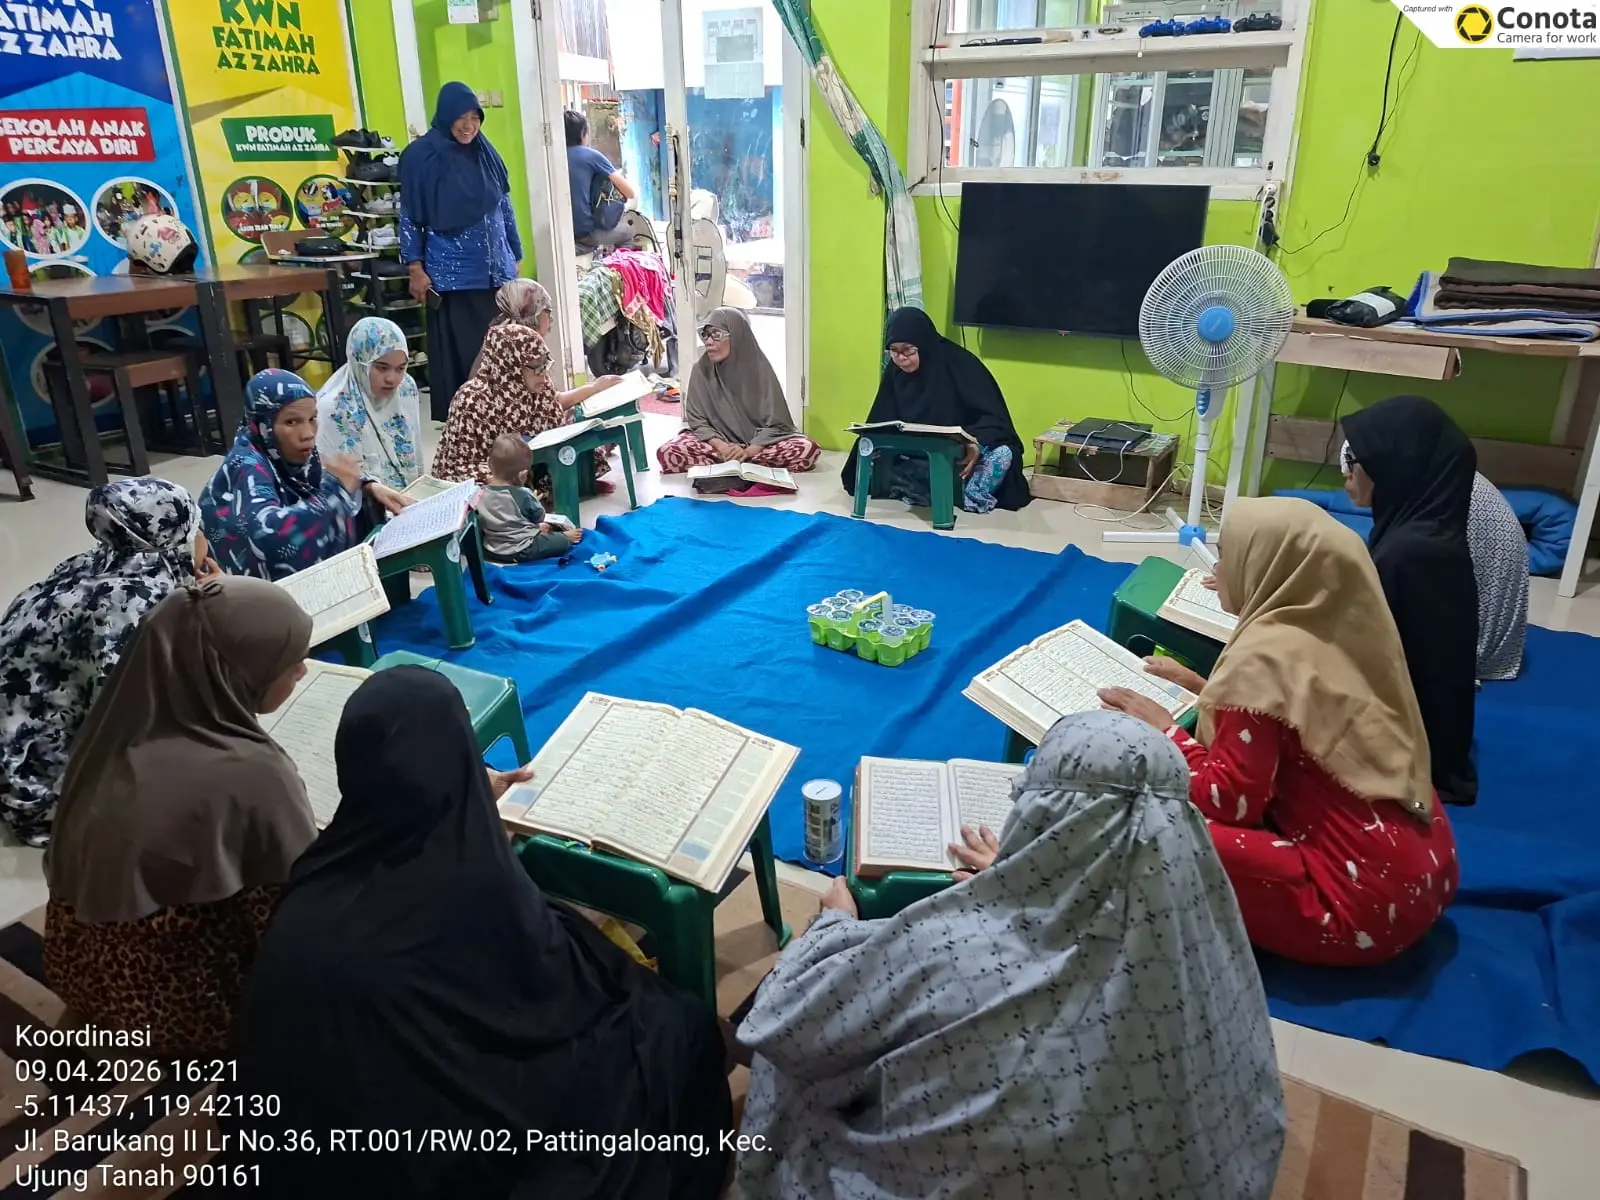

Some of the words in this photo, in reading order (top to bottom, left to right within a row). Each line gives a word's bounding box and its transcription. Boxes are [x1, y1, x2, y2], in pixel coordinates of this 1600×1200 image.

[0, 3, 115, 38] ATIMAH
[219, 0, 302, 32] KWN
[0, 31, 22, 55] Z
[24, 33, 122, 60] ZAHRA
[212, 26, 315, 55] FATIMAH
[217, 50, 248, 70] AZ
[250, 53, 320, 75] ZAHRA
[90, 119, 146, 137] ANAK
[245, 125, 317, 143] PRODUK
[8, 137, 99, 155] PERCAYA
[99, 138, 138, 156] DIRI
